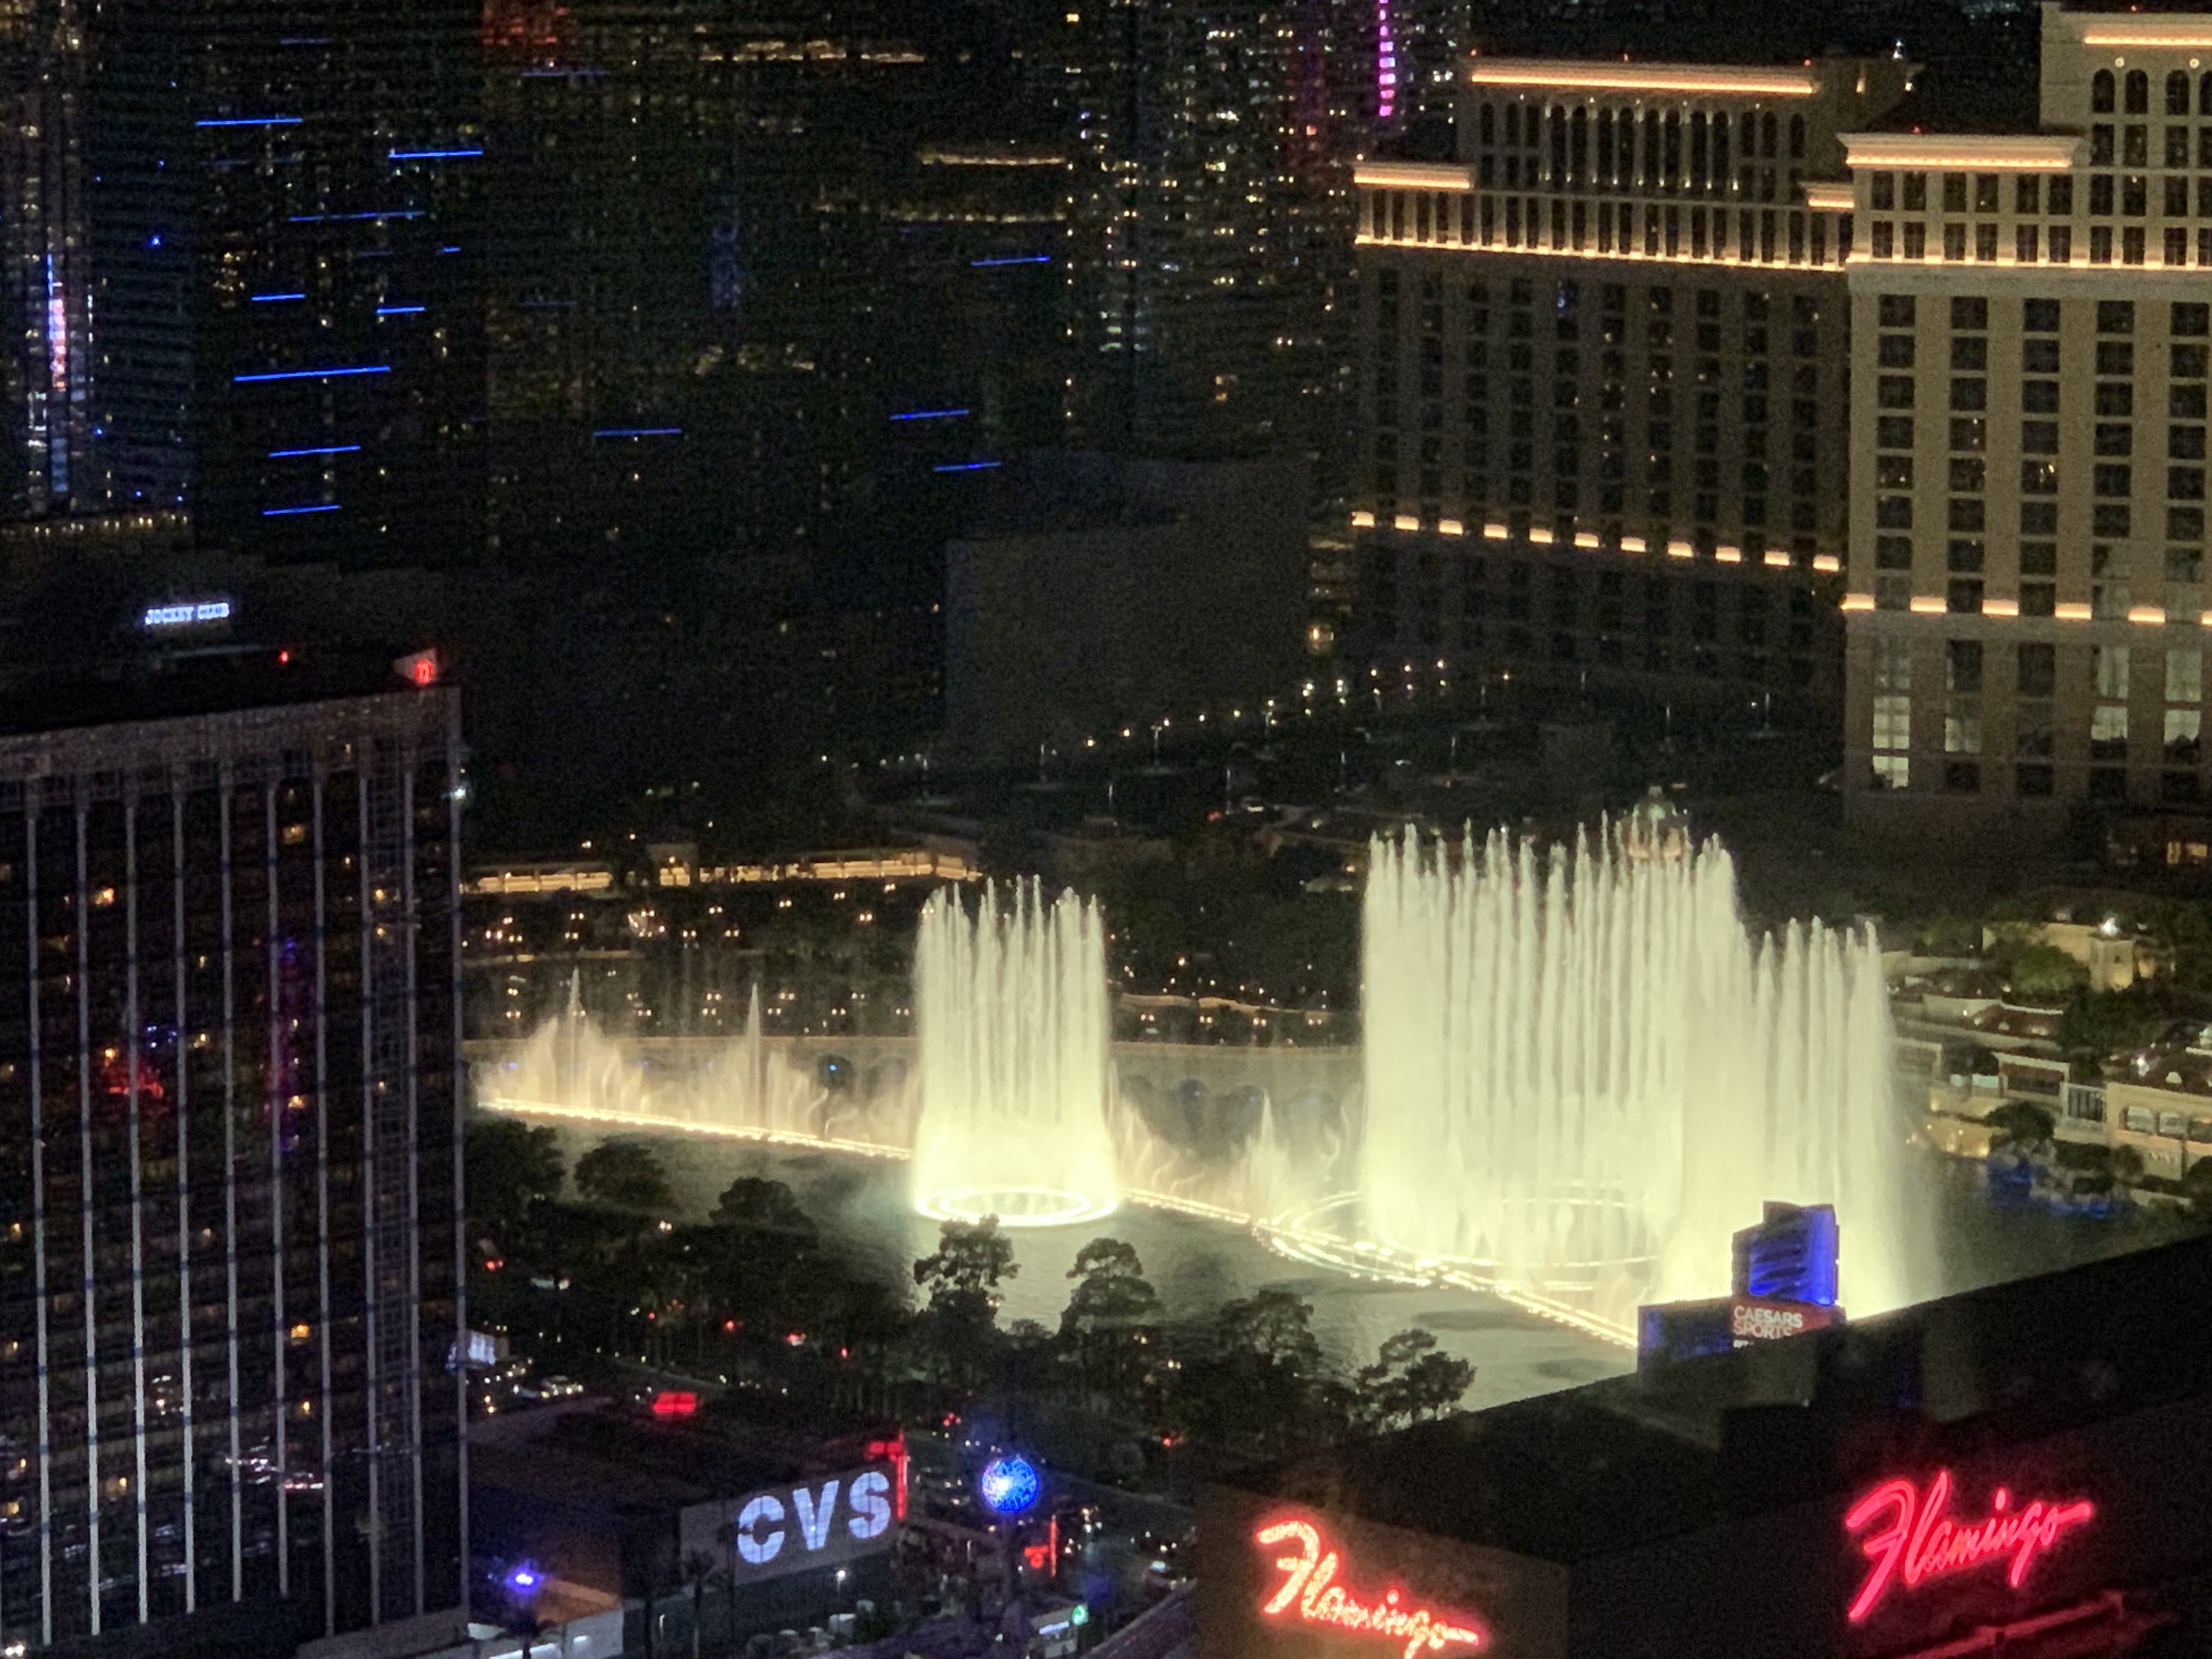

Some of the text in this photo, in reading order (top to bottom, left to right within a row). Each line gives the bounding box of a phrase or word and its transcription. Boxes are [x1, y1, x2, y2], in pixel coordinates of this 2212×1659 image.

[1732, 1318, 1792, 1339] SPORTS
[1733, 1305, 1803, 1328] CAESARS
[737, 1471, 891, 1563] CVS
[1846, 1470, 2092, 1620] Flamingo
[1256, 1519, 1481, 1658] Flamingo
